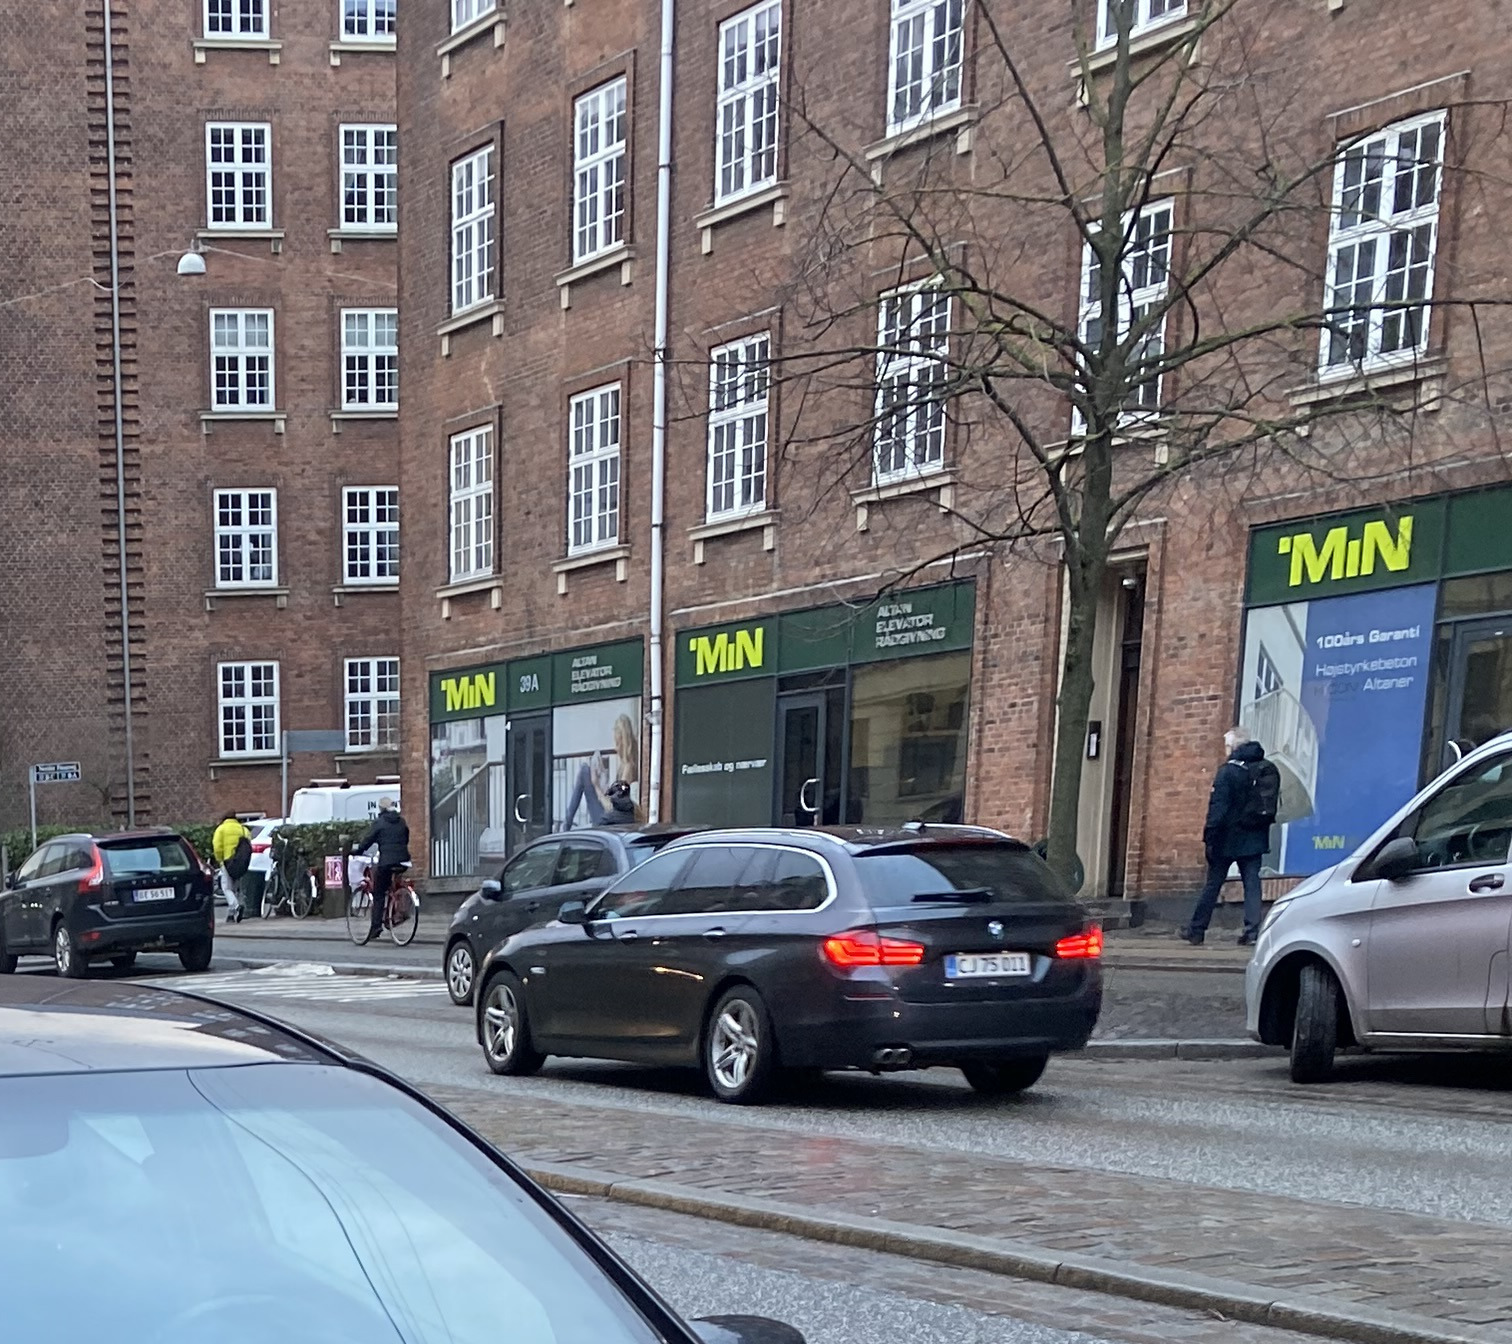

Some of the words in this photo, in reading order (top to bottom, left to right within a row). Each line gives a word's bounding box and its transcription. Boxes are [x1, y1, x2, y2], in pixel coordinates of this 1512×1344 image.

[876, 614, 934, 633] ELEVATOR
[1369, 625, 1420, 643] Garanti
[571, 665, 613, 683] ELEVATOR
[1363, 677, 1414, 691] Altaner
